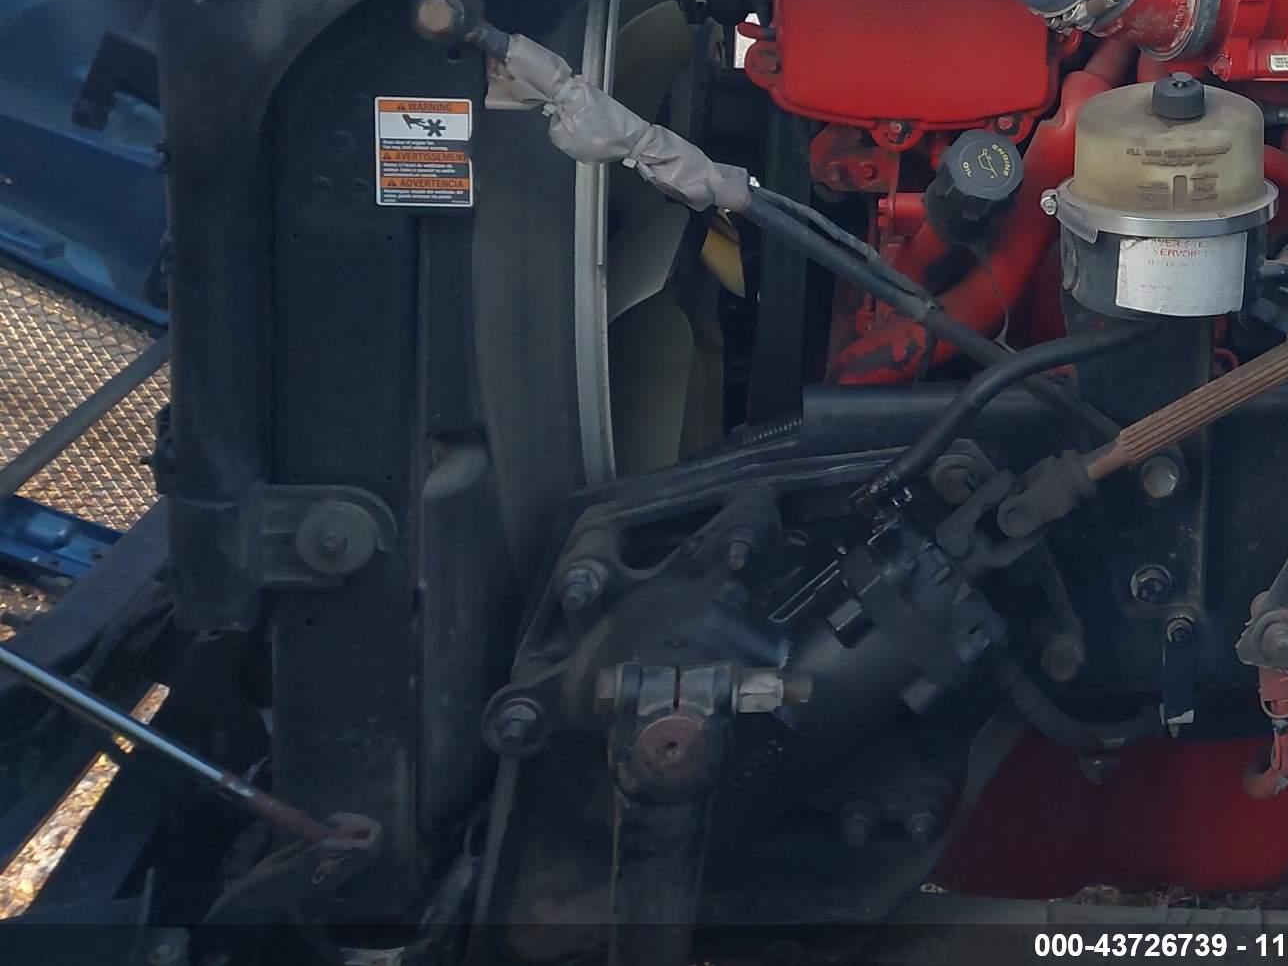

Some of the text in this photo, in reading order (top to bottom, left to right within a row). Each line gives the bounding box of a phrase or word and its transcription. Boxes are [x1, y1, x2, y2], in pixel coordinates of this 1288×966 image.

[408, 102, 453, 112] WARNING
[962, 143, 1012, 178] ENGINE OIL
[400, 178, 464, 188] ADVERTENCIA
